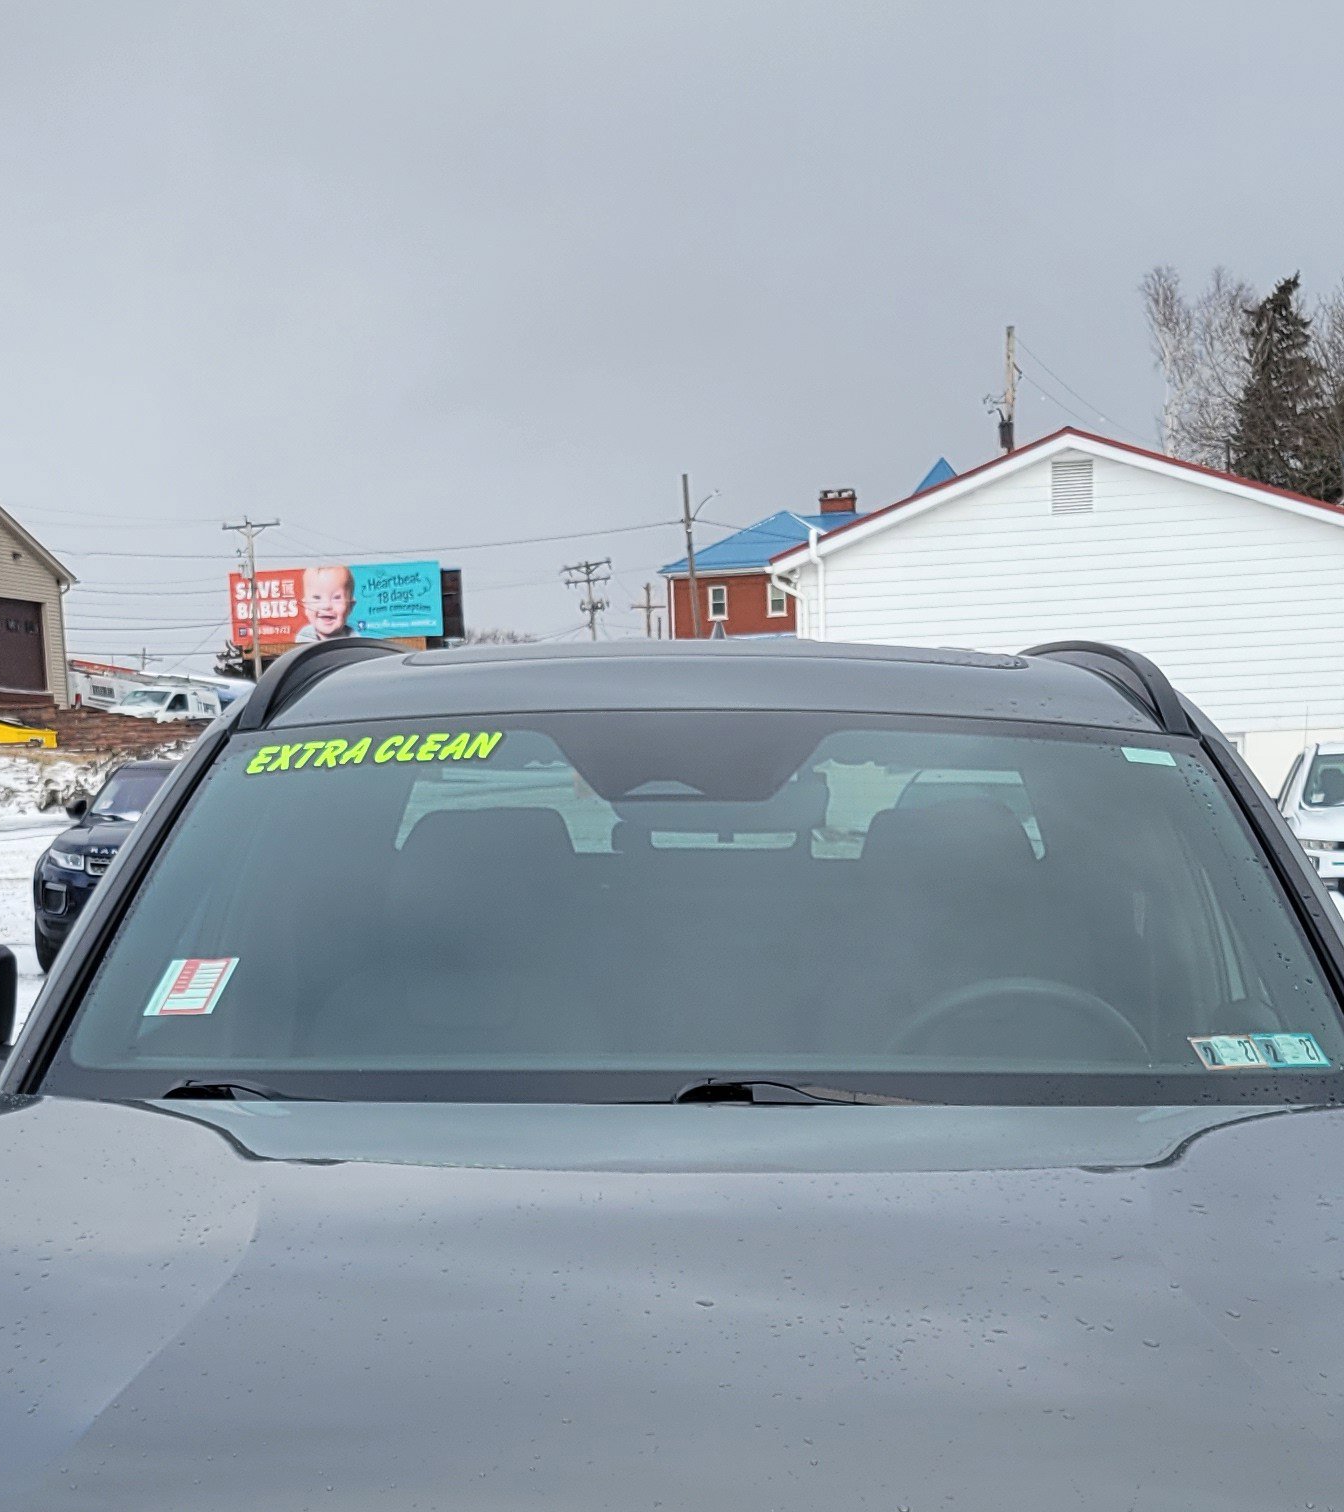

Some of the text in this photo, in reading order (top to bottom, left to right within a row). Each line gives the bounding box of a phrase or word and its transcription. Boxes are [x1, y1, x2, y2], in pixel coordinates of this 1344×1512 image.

[235, 581, 280, 600] SAVE
[367, 572, 421, 591] Heartbeat
[377, 589, 414, 604] 18 days
[237, 600, 298, 619] BABIES
[246, 732, 502, 774] EXTRA CLEAN
[1237, 1040, 1260, 1063] 27
[1298, 1039, 1320, 1062] 27
